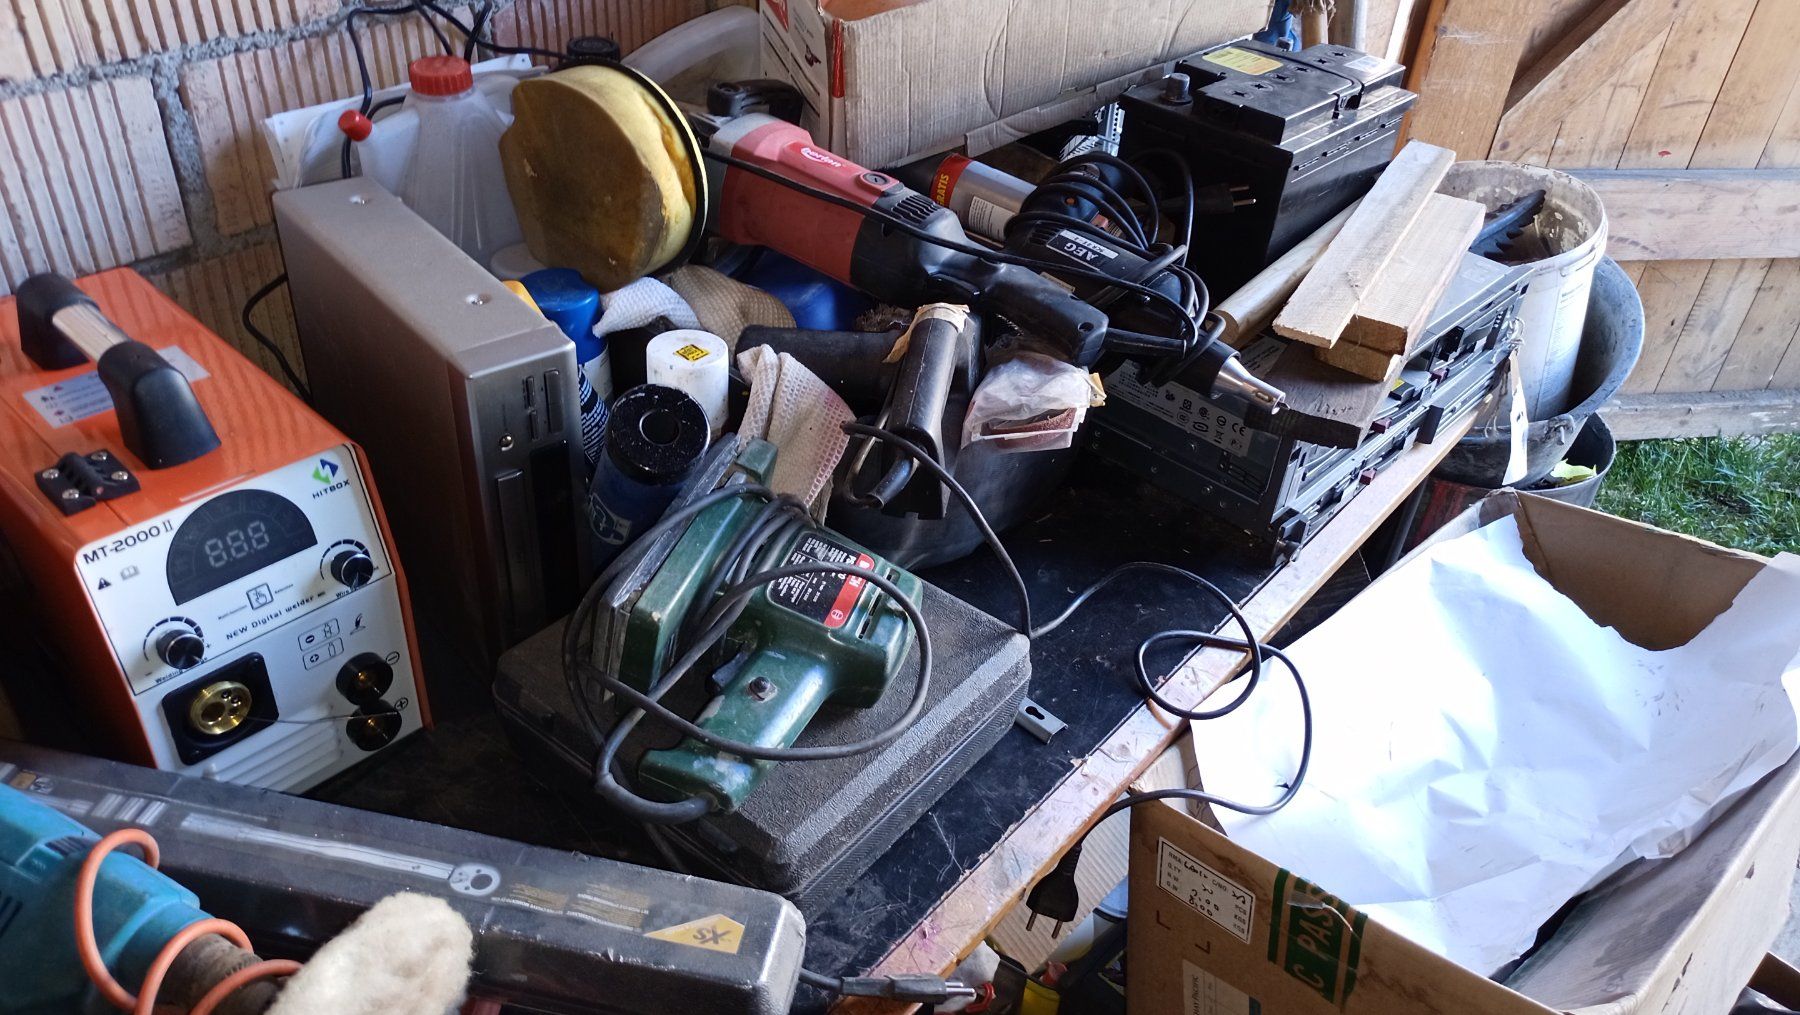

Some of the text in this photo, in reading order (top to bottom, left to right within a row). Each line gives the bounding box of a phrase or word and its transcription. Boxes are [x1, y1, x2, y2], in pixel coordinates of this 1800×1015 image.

[1064, 242, 1099, 261] AEG
[312, 479, 350, 500] HITBOX
[82, 525, 161, 565] MT-2000
[226, 625, 249, 641] NEW
[251, 610, 283, 629] Digital
[285, 595, 314, 614] welder
